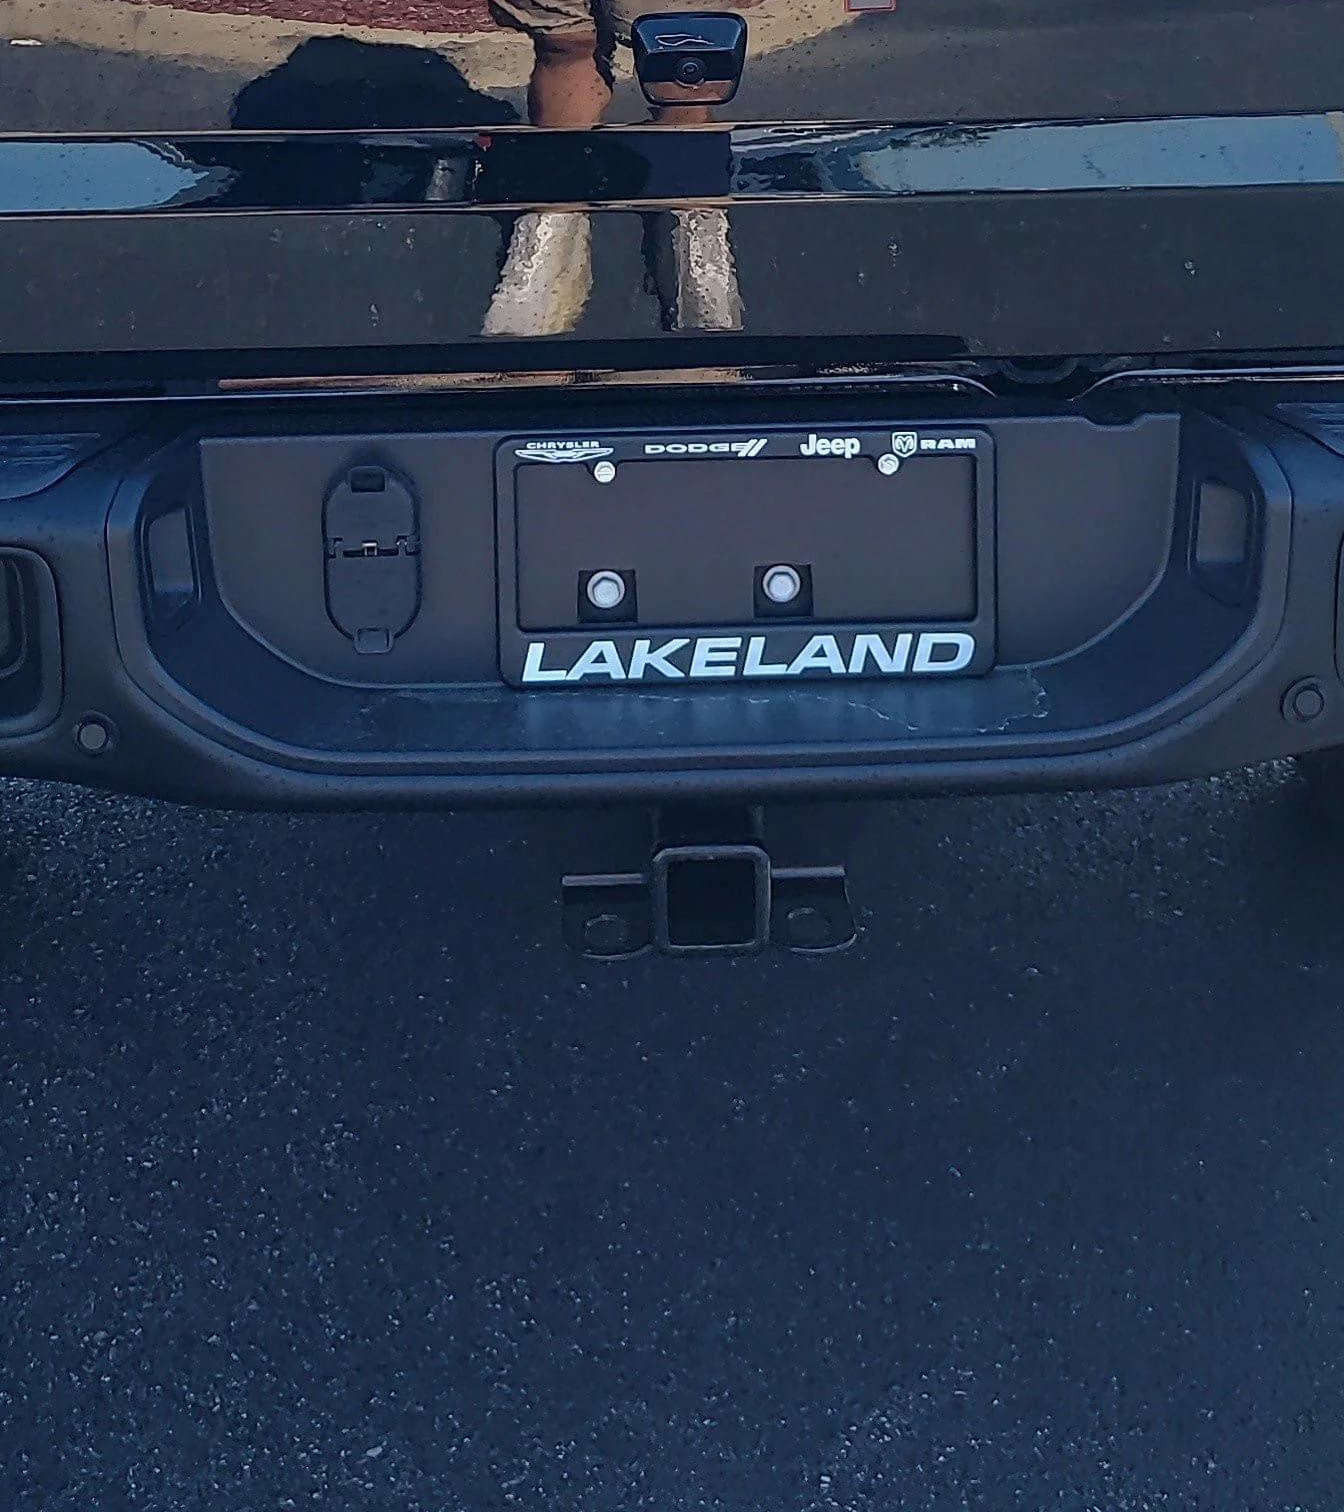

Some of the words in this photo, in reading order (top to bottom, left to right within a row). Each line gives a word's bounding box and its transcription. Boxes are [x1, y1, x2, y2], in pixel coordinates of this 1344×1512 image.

[526, 440, 600, 450] CHRYSLER
[644, 442, 748, 455] DODGE
[799, 433, 861, 459] Jeep
[920, 438, 977, 450] RAM
[521, 632, 976, 682] LAKELAND
